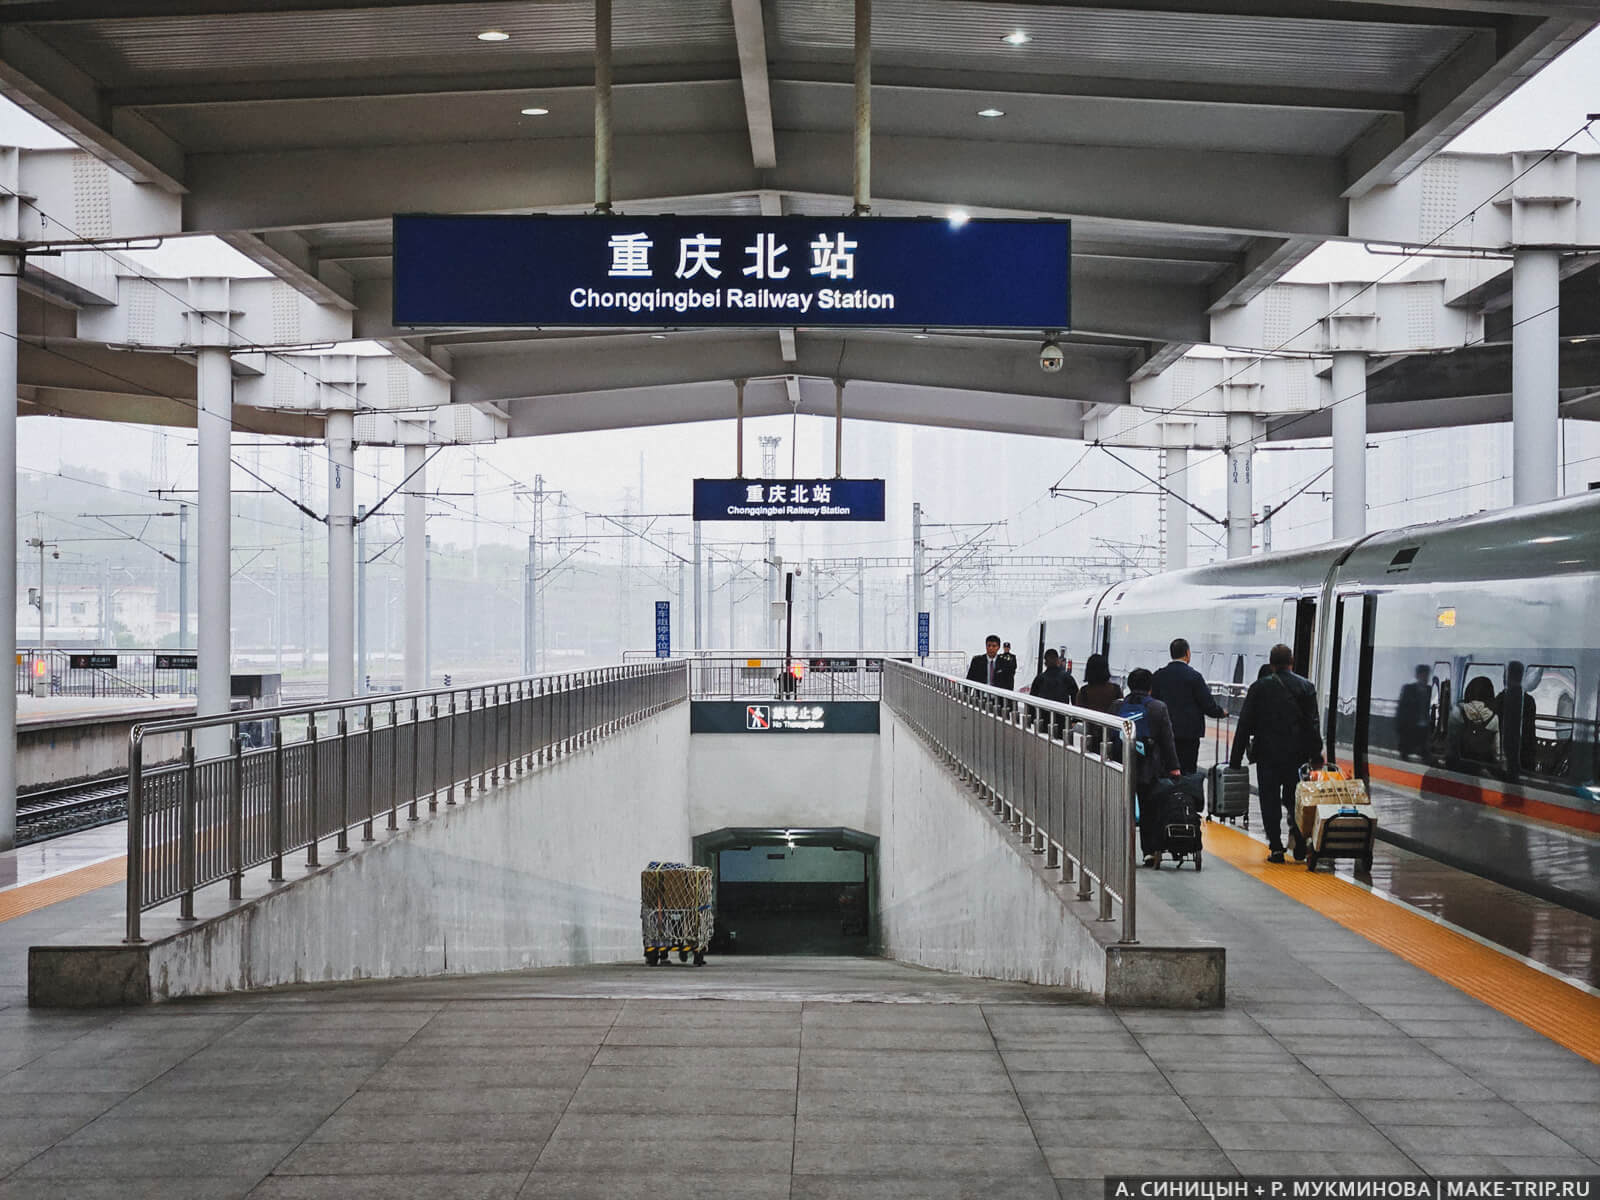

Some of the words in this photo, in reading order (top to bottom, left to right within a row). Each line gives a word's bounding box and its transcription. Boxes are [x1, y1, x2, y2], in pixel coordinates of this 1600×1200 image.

[607, 231, 858, 280] 重庆北站
[570, 287, 721, 314] Chongqingbei
[726, 287, 814, 314] Railway
[818, 289, 895, 309] Station
[745, 484, 832, 503] 重庆北站
[727, 505, 785, 516] Chongqingbei
[786, 505, 821, 516] Railway
[821, 505, 851, 515] Station
